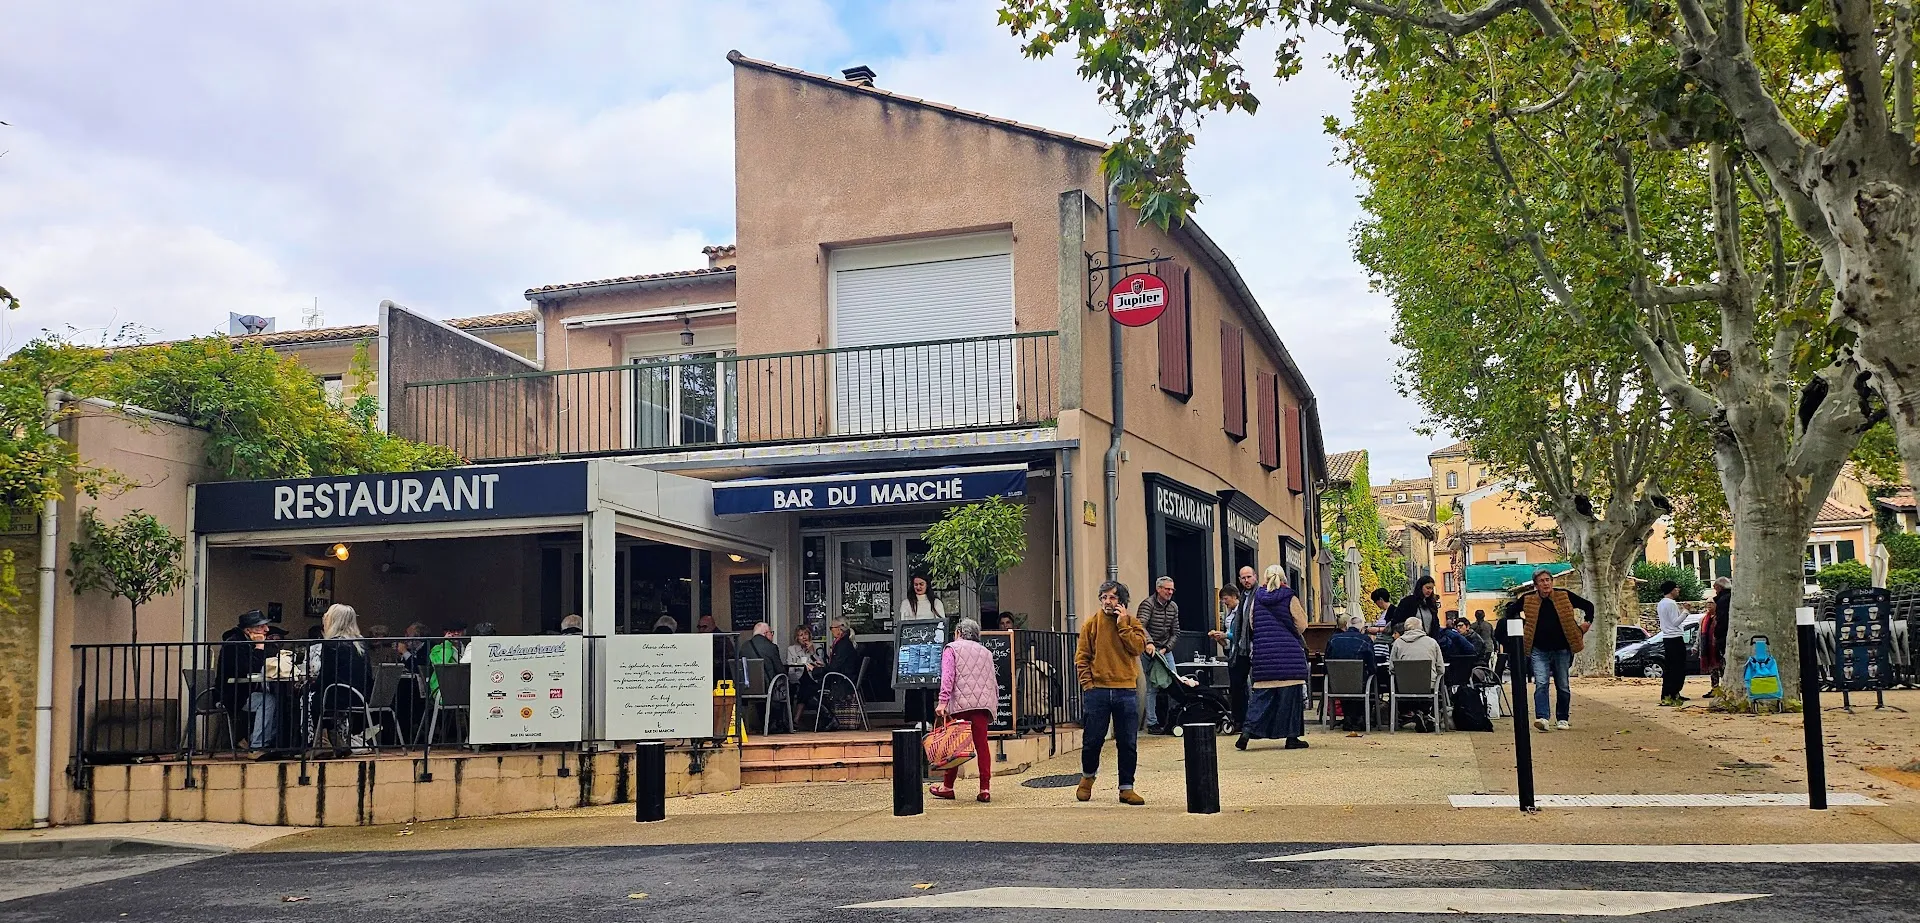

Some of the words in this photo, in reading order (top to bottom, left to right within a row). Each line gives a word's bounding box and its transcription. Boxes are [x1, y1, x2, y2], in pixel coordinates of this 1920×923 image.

[1117, 293, 1160, 308] Jupiler
[273, 473, 500, 521] RESTAURANT
[773, 486, 815, 510] BAR
[828, 484, 857, 506] DU
[870, 476, 964, 504] MARCHÉ
[1157, 487, 1212, 527] RESTAURANT
[1227, 508, 1237, 532] BAR
[1236, 514, 1243, 534] DU
[844, 579, 890, 594] Restaurant
[488, 641, 566, 657] Restaurant
